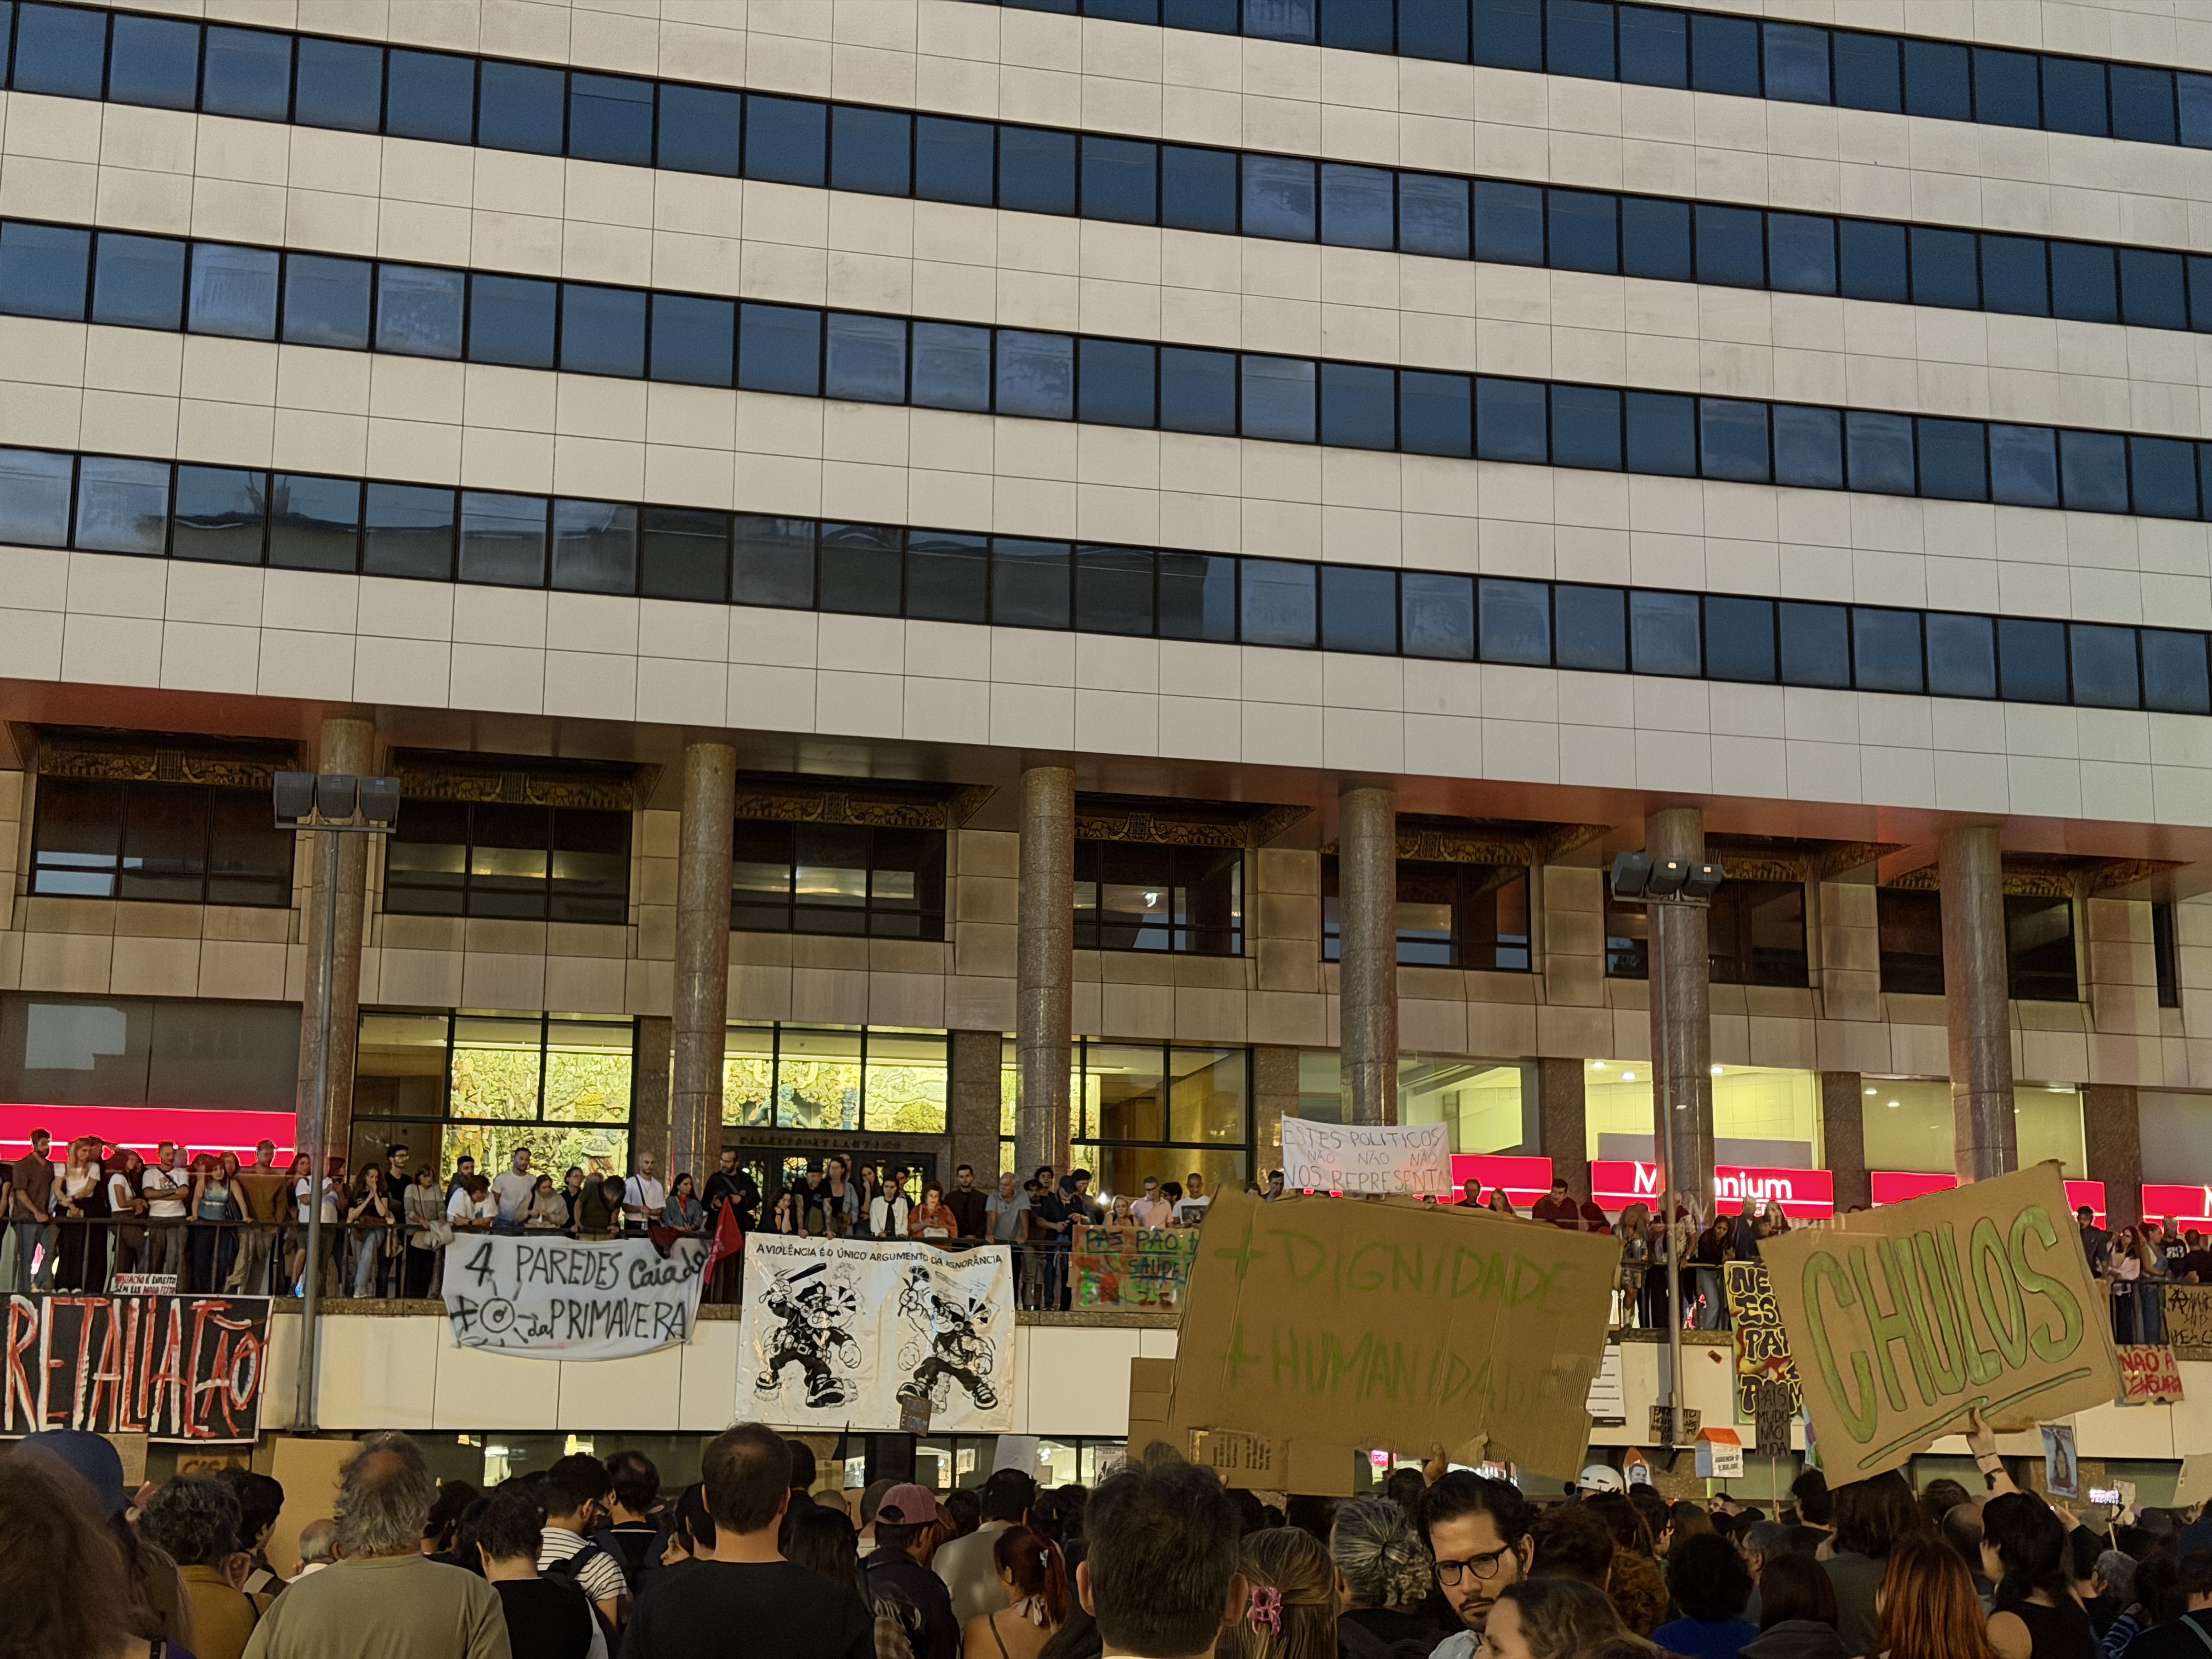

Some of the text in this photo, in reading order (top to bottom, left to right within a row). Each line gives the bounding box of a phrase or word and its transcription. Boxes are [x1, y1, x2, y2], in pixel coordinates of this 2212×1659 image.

[1283, 1120, 1342, 1150] ESTES
[1307, 1149, 1335, 1165] NÃO
[1357, 1149, 1390, 1165] NÃO
[1136, 1228, 1180, 1250] PÃO
[465, 1241, 495, 1286] 4
[515, 1244, 623, 1290] PAREDES
[756, 1243, 1003, 1269] A VIOLÊNCIA É O ÚNICO ARGUMENTO DA IGNORÂNCIA
[550, 1298, 686, 1341] PRIMAVERA
[1802, 1205, 2084, 1444] CHULOS
[1757, 1408, 1789, 1425] MUDO
[1757, 1441, 1788, 1456] MUDA
